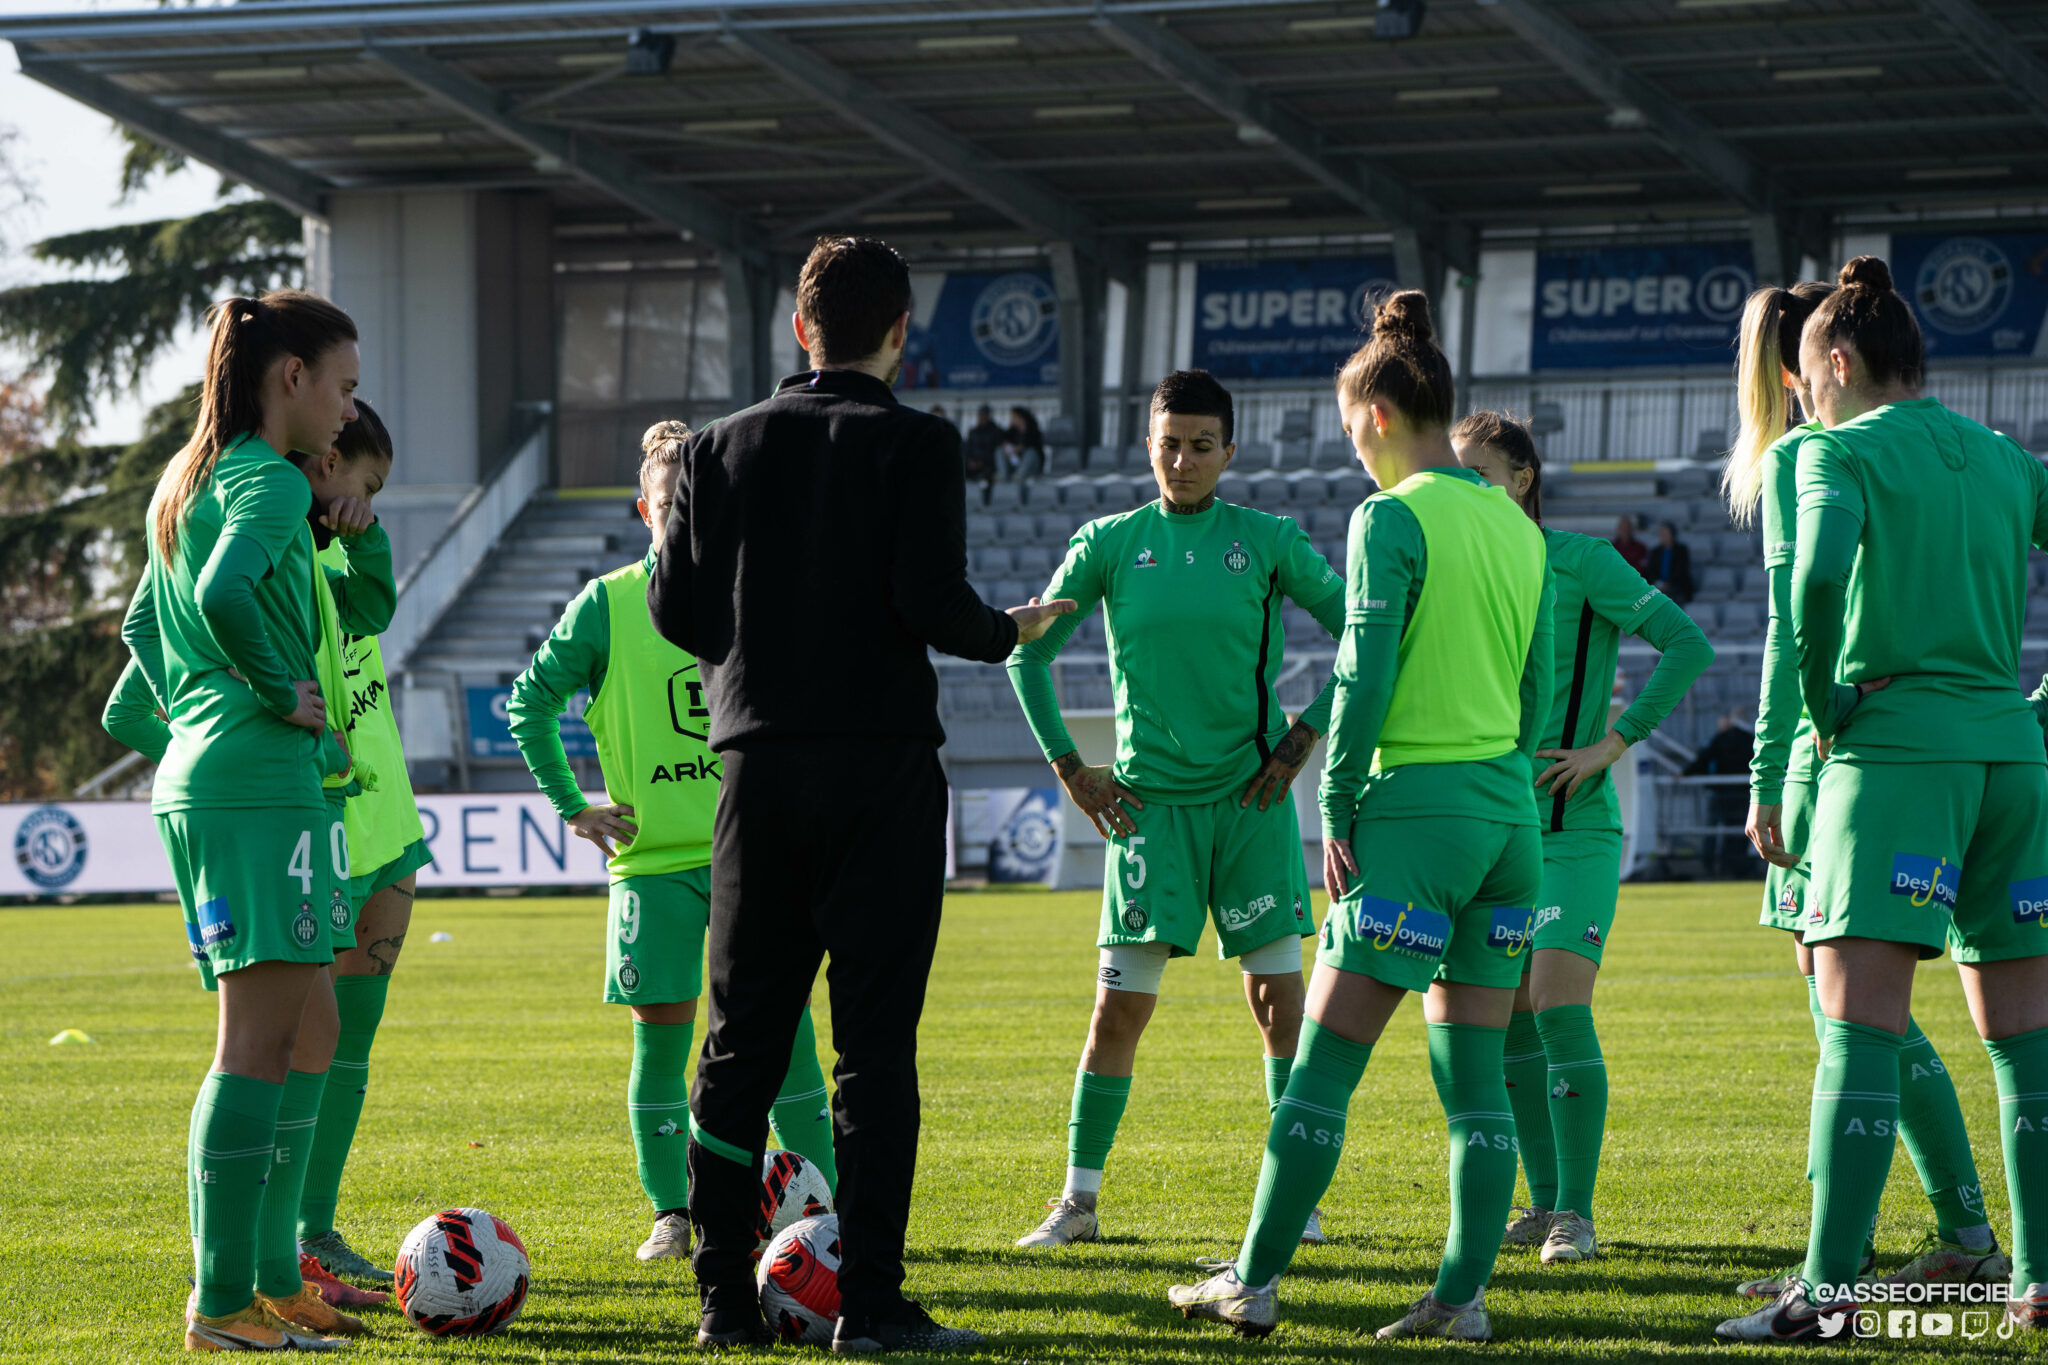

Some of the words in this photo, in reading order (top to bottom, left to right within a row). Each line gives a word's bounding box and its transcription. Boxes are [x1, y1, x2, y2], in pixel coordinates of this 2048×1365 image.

[1202, 288, 1347, 330] SUPER
[1541, 275, 1692, 318] SUPER
[1185, 550, 1195, 565] 5
[1631, 602, 1641, 612] LE
[287, 830, 313, 895] 4
[1126, 836, 1147, 890] 5
[619, 889, 640, 945] 9
[1228, 894, 1278, 924] SUPER
[1288, 1121, 1344, 1149] ASS
